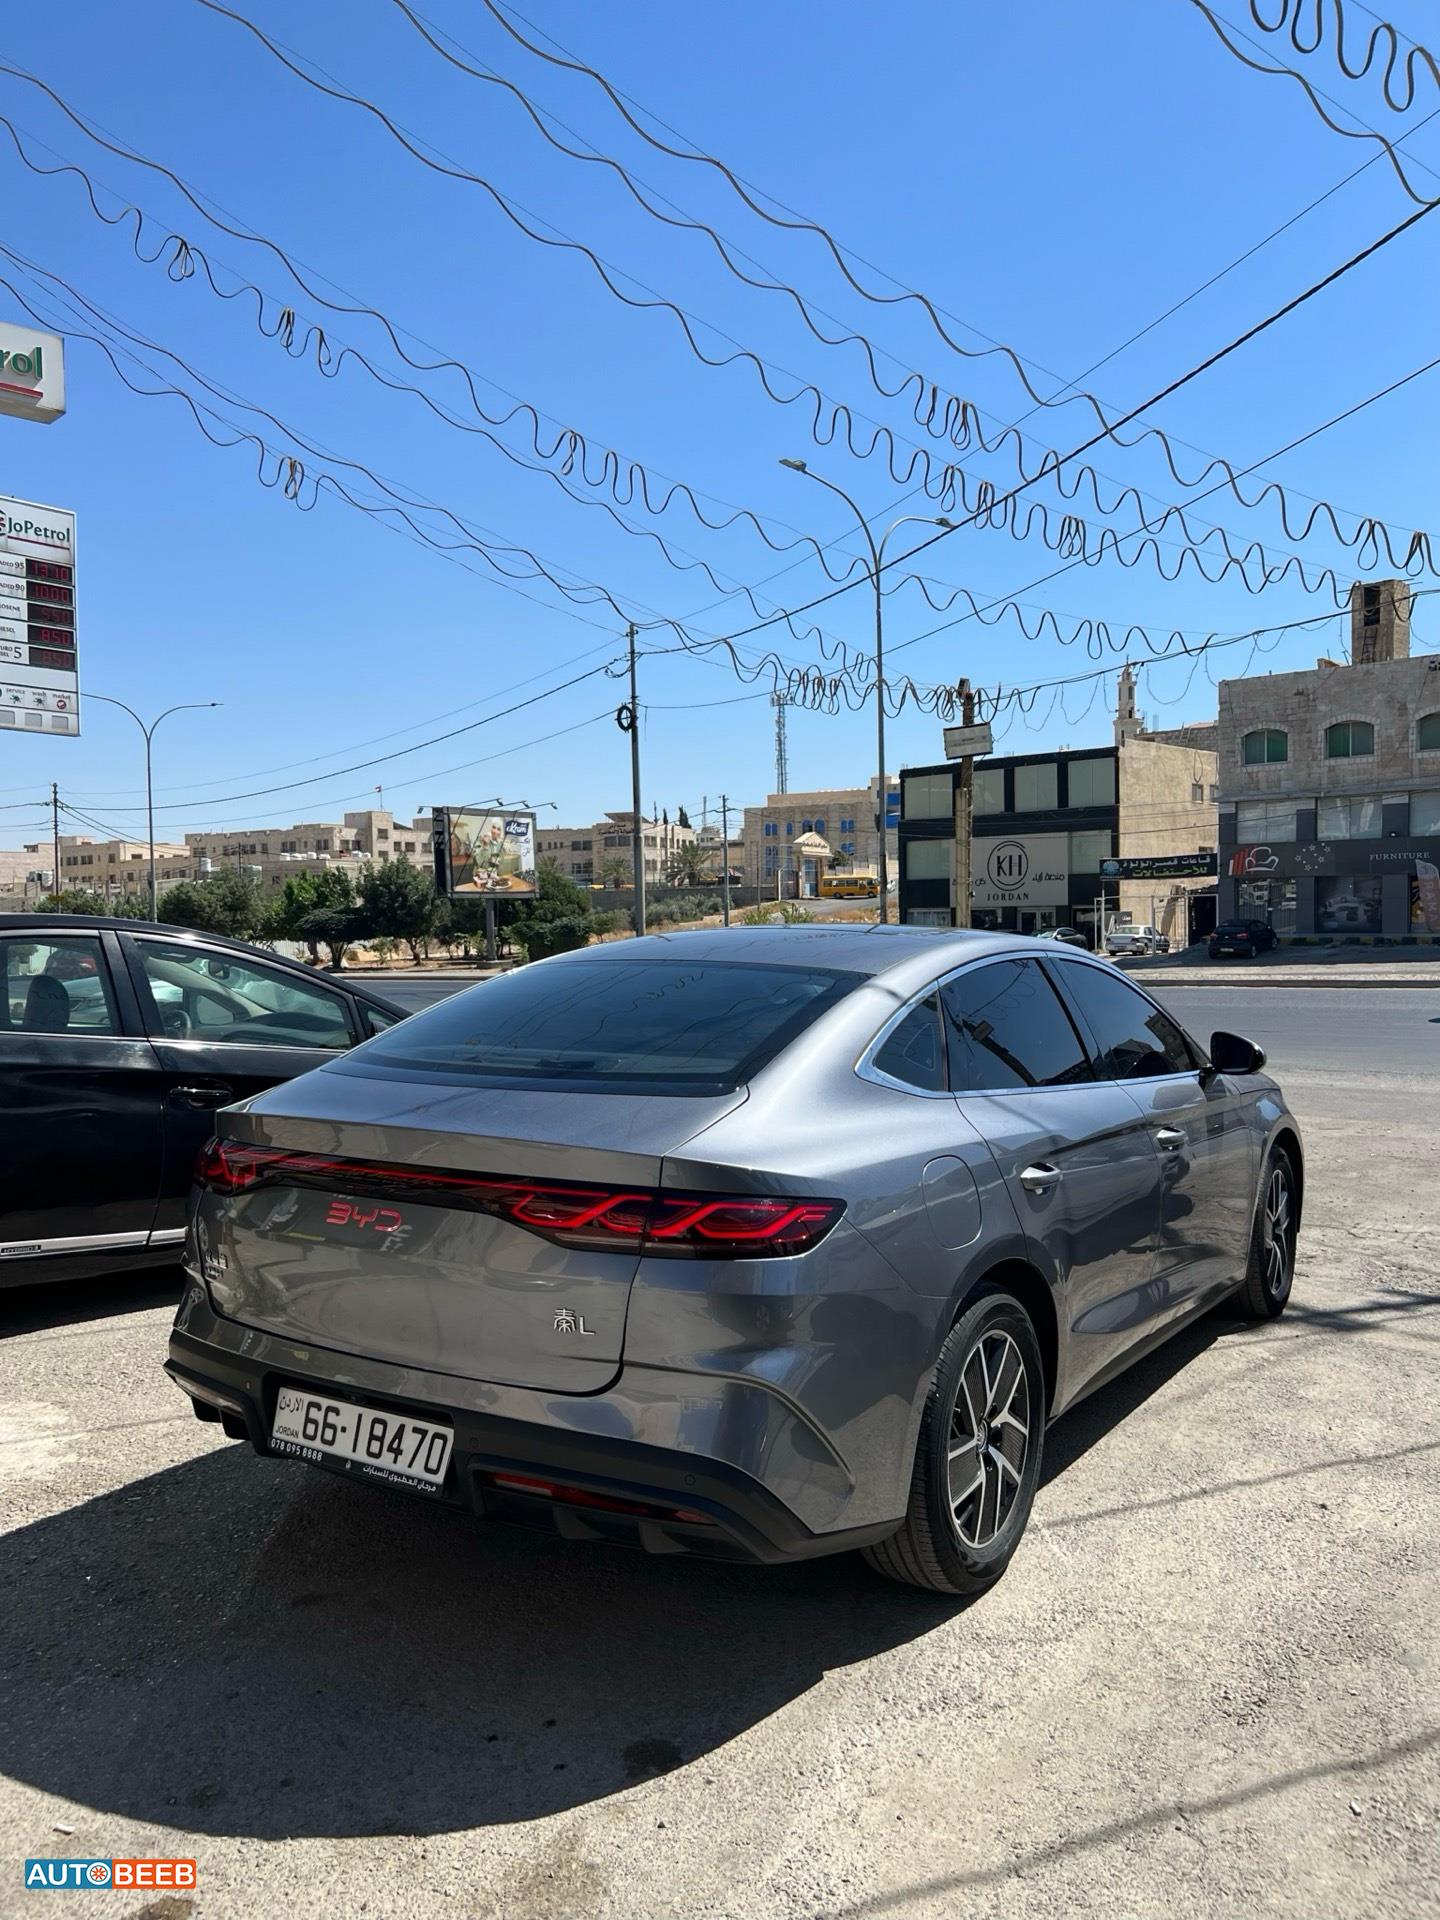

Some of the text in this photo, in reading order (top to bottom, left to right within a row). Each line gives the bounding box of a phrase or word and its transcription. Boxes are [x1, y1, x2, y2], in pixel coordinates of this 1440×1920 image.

[8, 517, 70, 542] JoPetrol
[15, 561, 25, 569] 95
[41, 629, 70, 646] 850
[14, 647, 22, 659] 5
[1369, 852, 1430, 861] FURNITURE
[987, 893, 1029, 901] JORDAN
[275, 1424, 299, 1439] JORDAN
[271, 1438, 323, 1461] 078 095 8888
